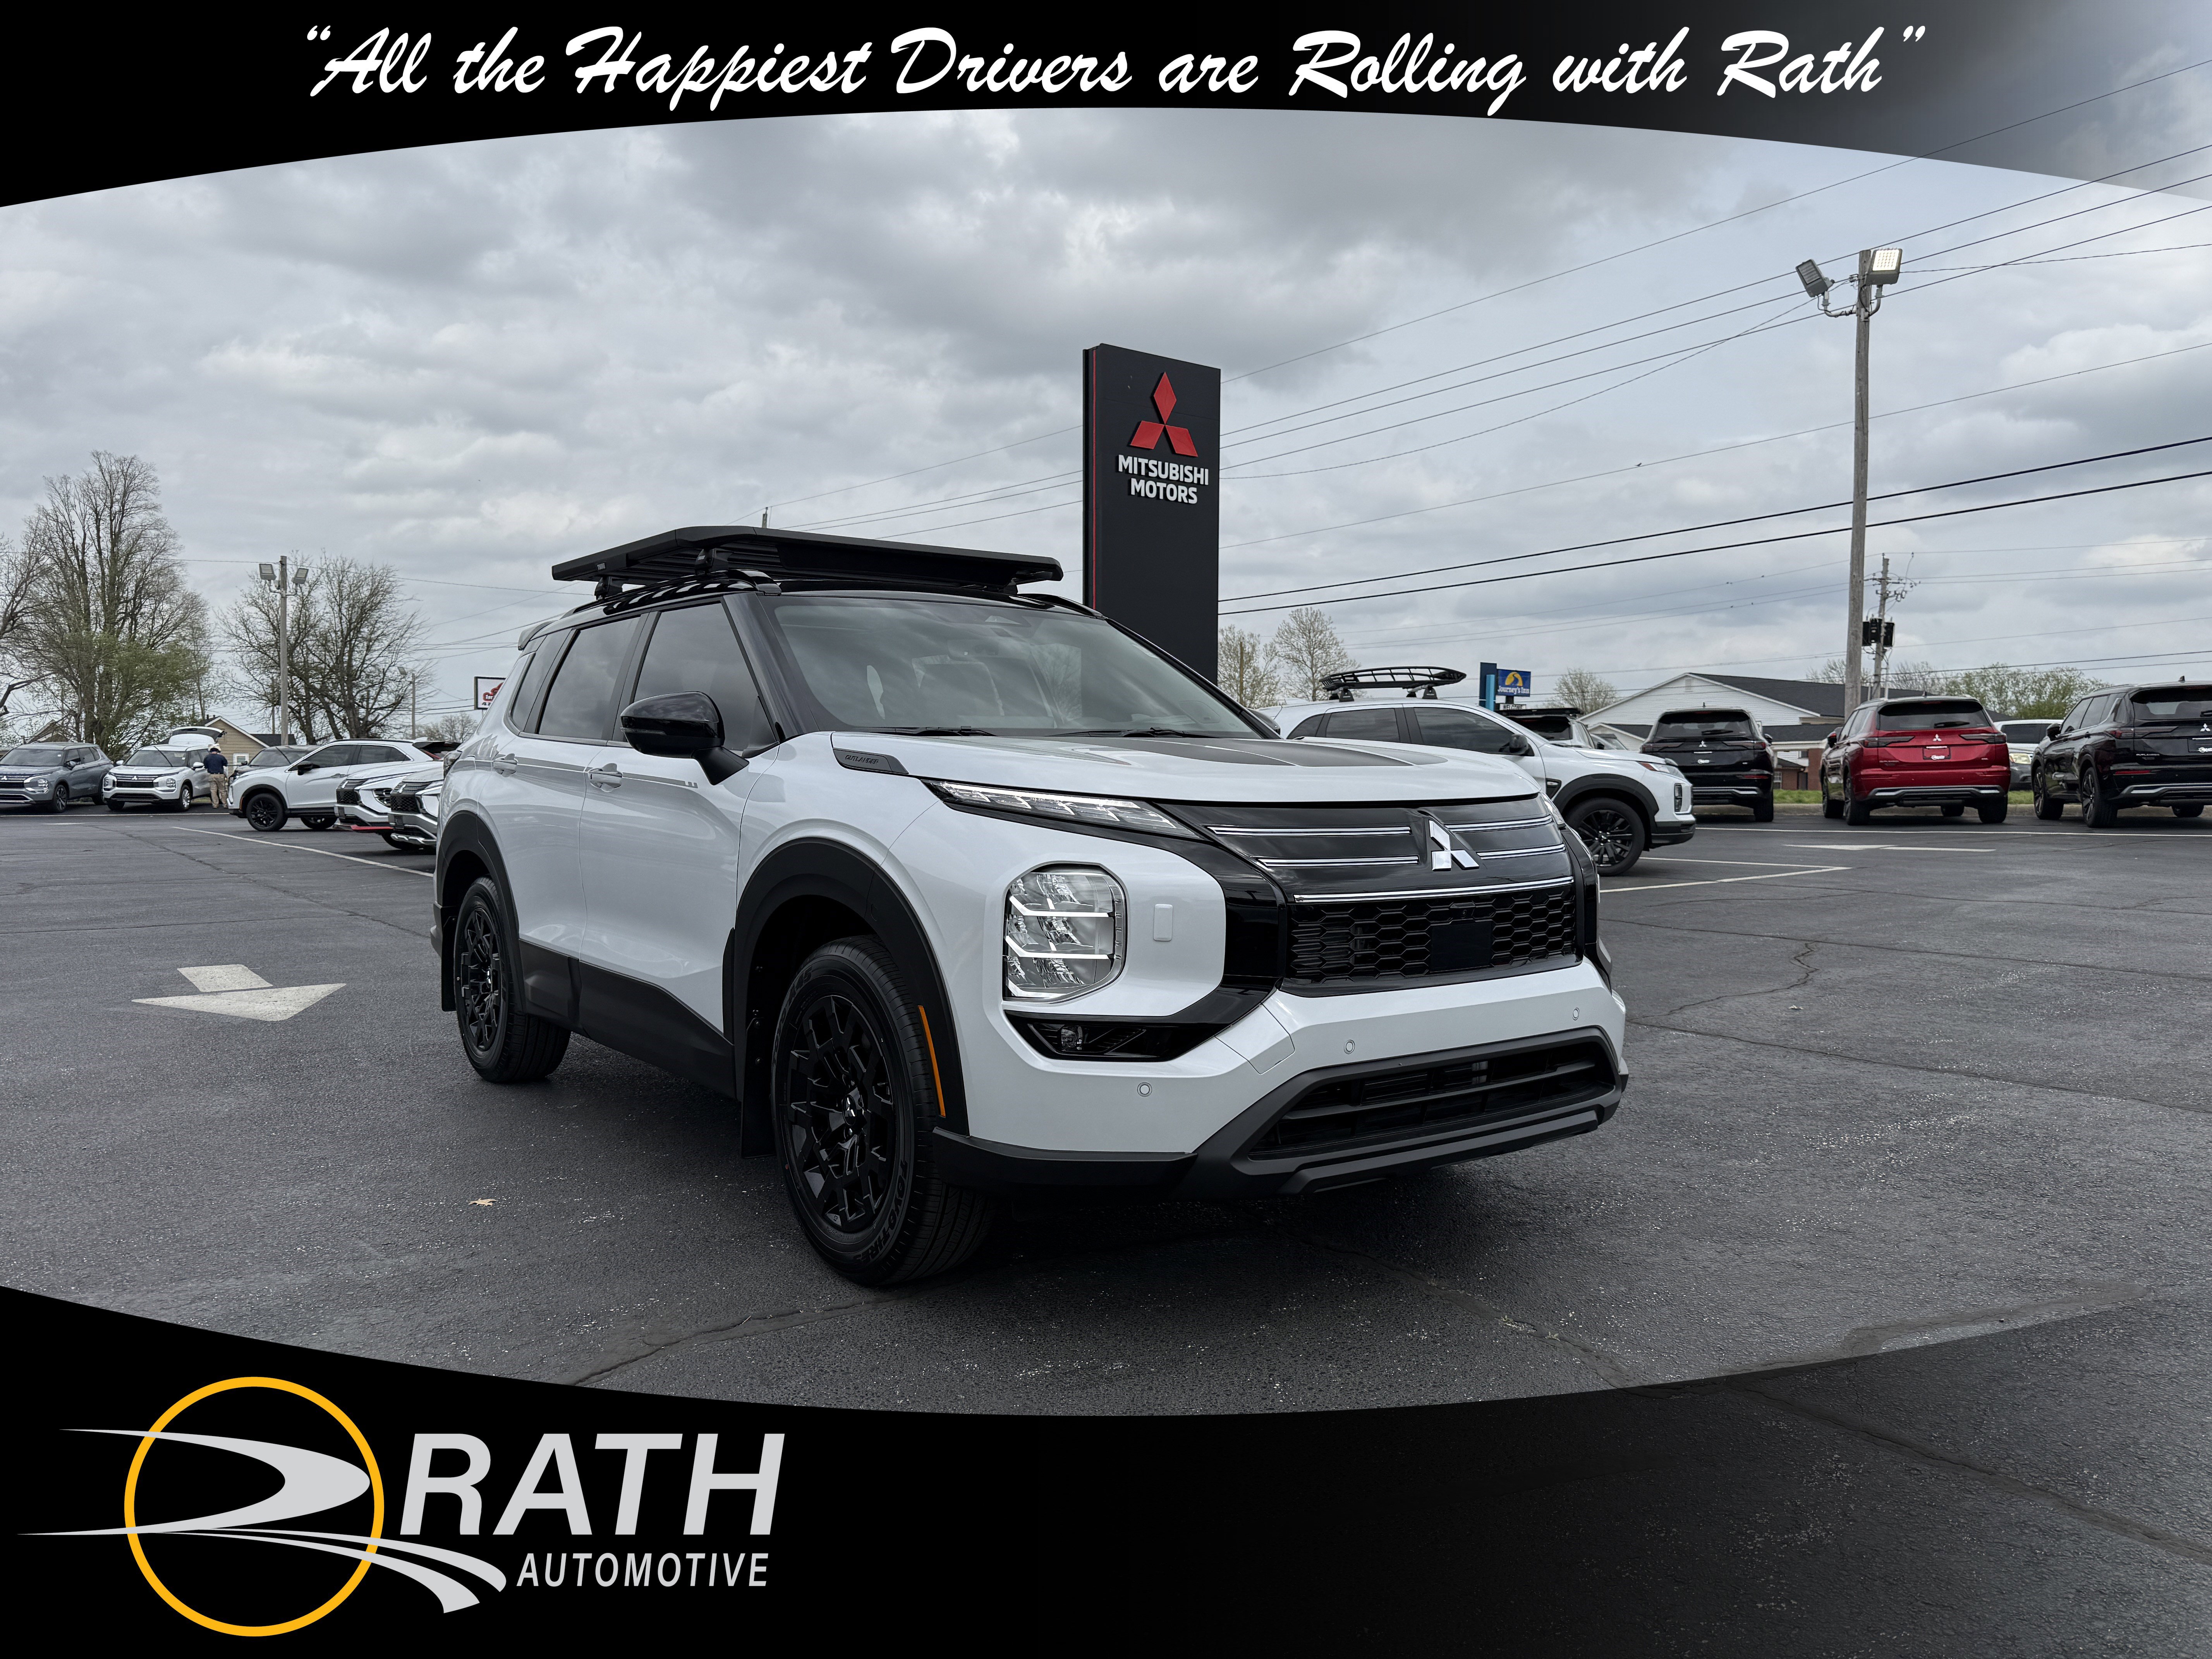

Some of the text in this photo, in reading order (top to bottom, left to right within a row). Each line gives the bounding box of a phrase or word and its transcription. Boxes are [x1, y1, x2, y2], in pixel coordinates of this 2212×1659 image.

[1118, 454, 1209, 485] MITSUBISHI
[1130, 478, 1197, 504] MOTORS
[1498, 685, 1520, 694] Journey's
[845, 755, 879, 764] OUTLANDER
[853, 1159, 908, 1262] TOYO TIRES
